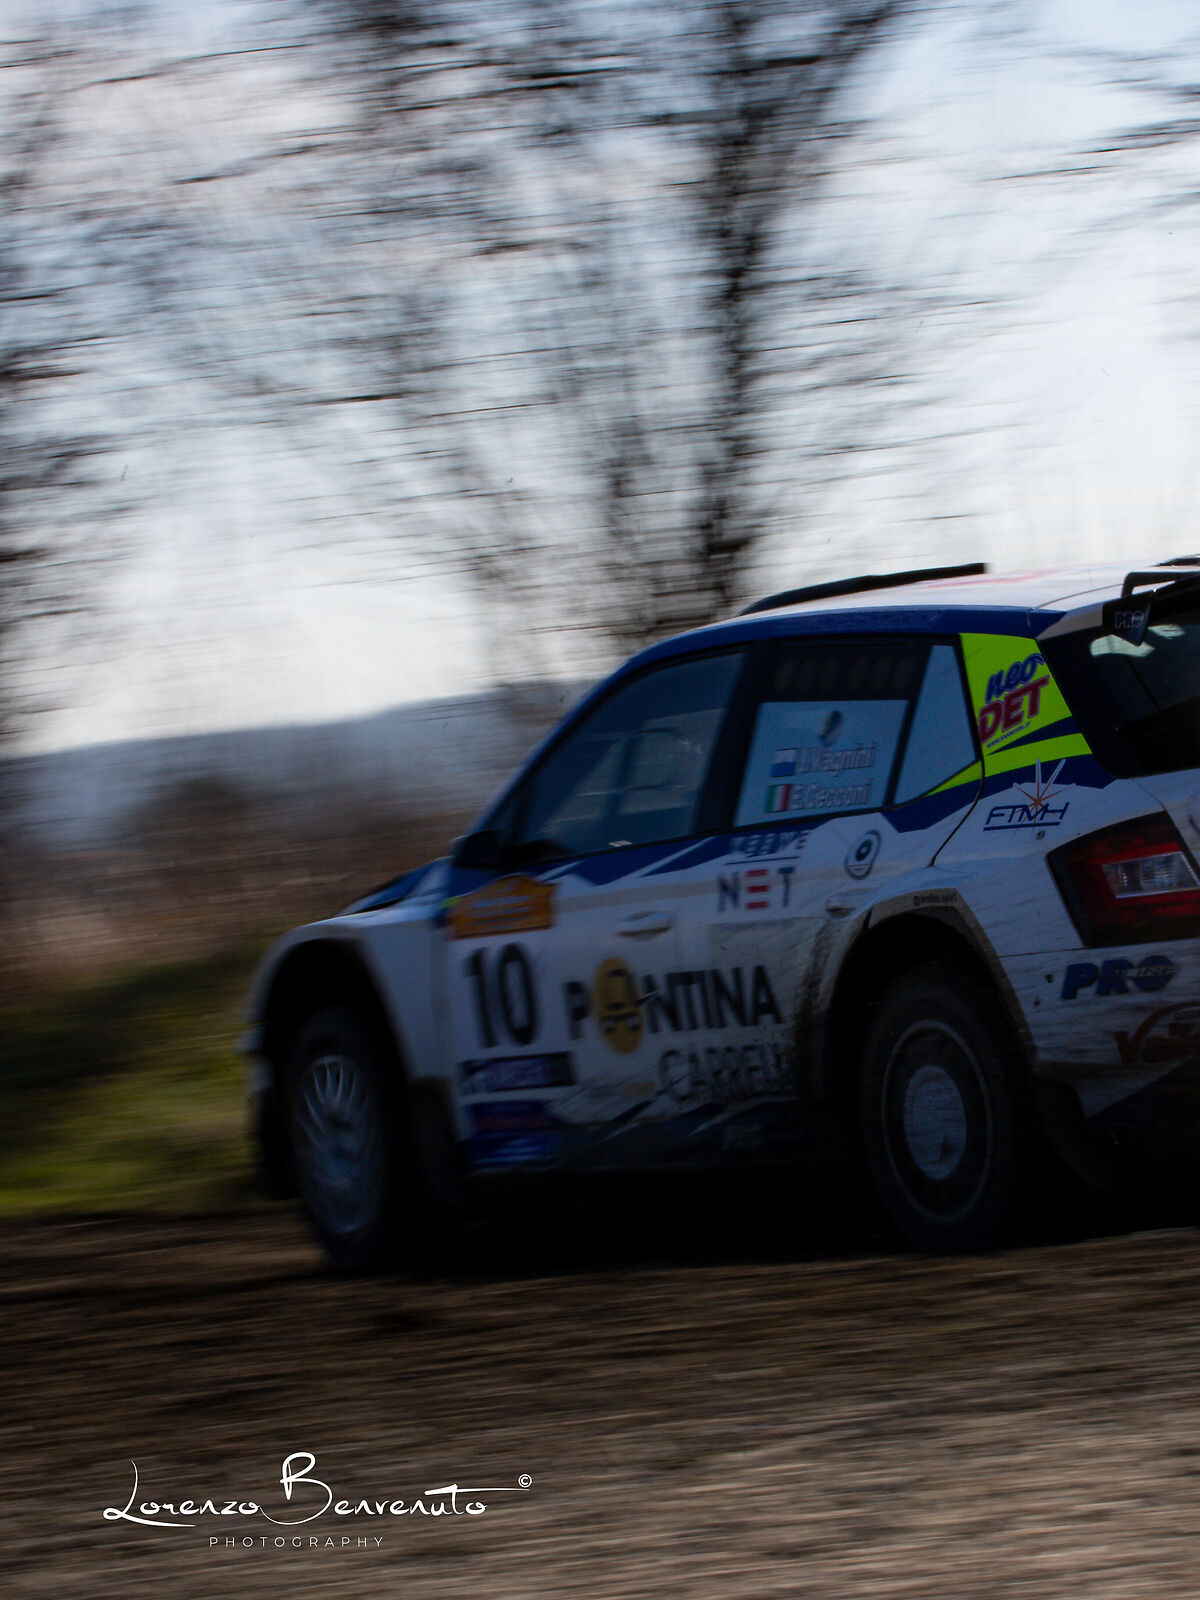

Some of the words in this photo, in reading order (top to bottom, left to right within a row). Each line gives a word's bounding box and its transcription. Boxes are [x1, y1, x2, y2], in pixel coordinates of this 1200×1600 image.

[979, 674, 1050, 743] DET
[466, 942, 535, 1049] 10
[1061, 955, 1175, 1000] PRO
